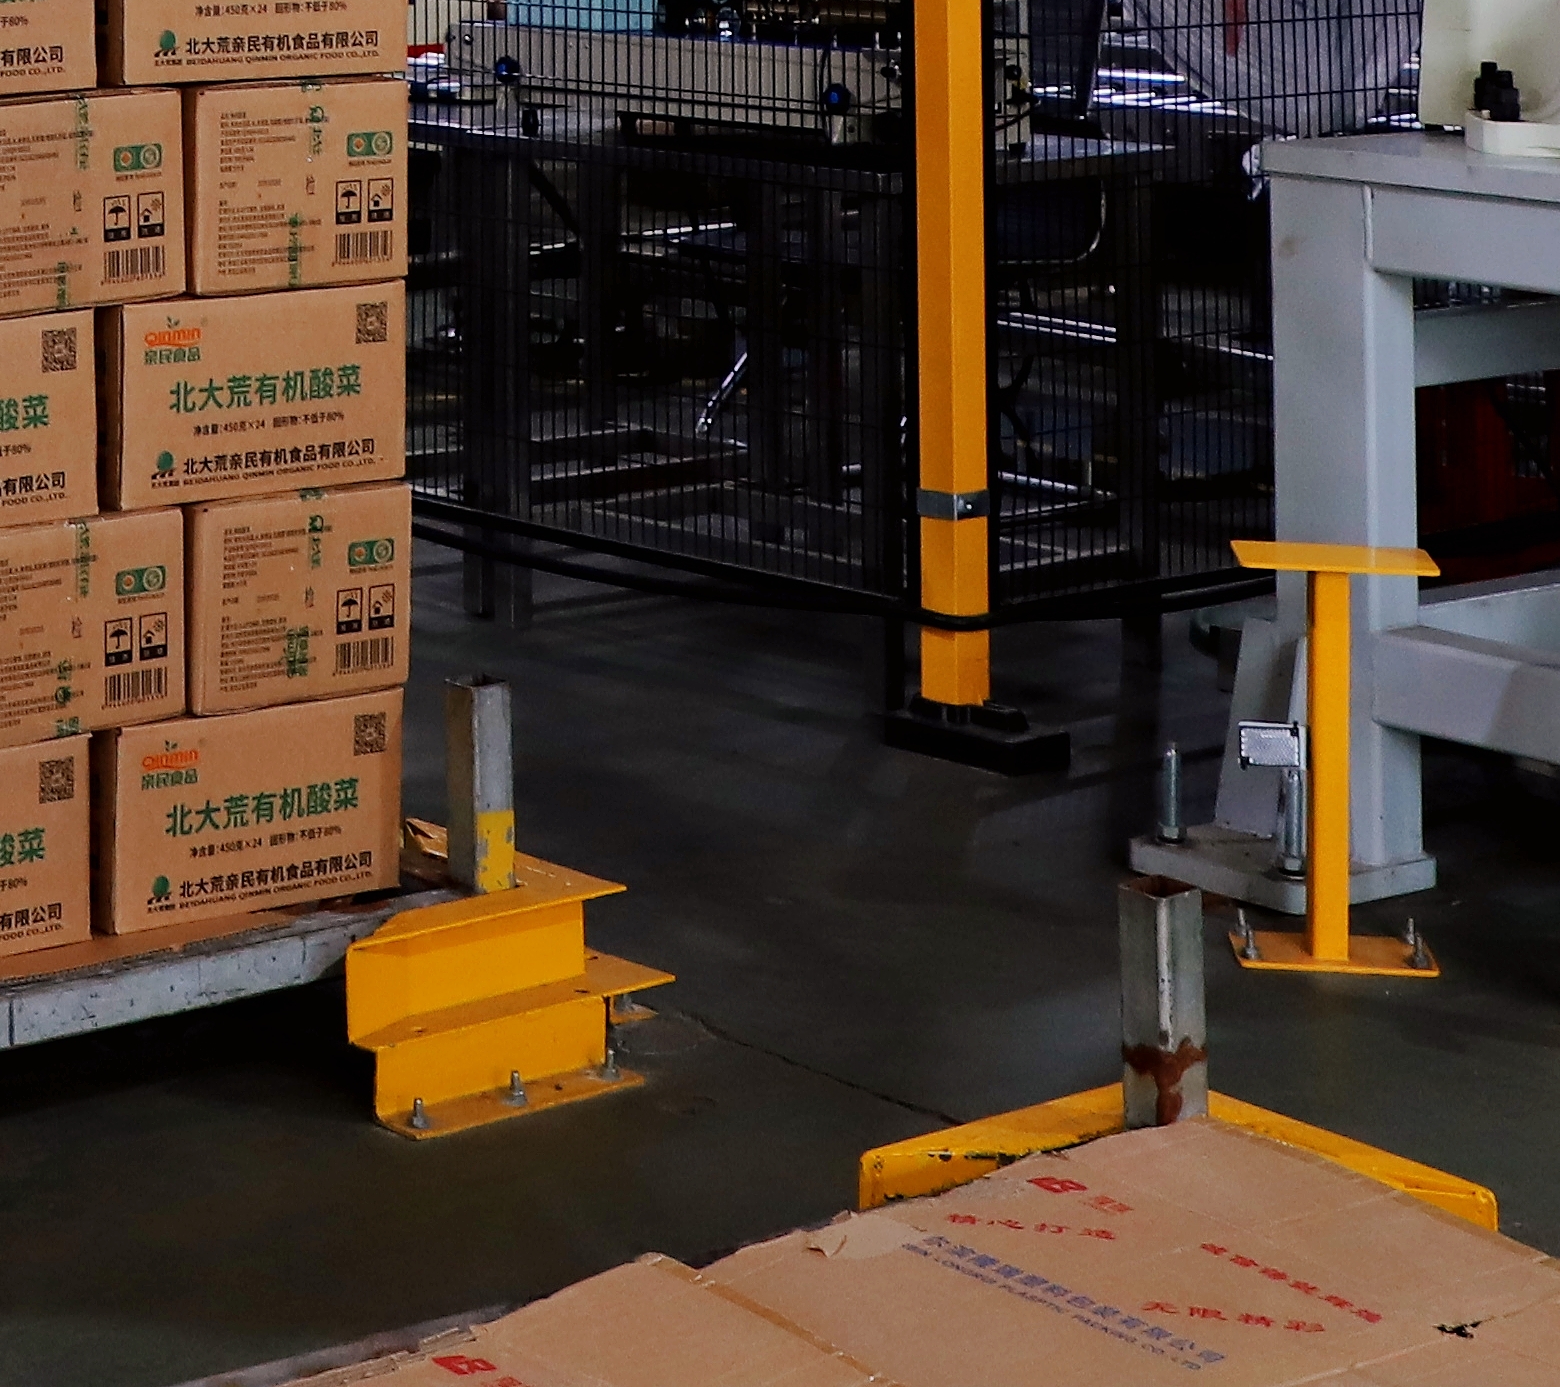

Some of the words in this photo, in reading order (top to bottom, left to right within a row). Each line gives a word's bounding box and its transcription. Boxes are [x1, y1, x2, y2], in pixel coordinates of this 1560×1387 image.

[186, 30, 378, 55] 北大荒亲民有机食品有限公司
[169, 364, 361, 415] 北大荒有机酸菜
[2, 496, 28, 506] FOOD
[165, 776, 359, 838] 北大荒有机酸菜
[179, 850, 371, 899] 北大荒亲民有机食品有限公司
